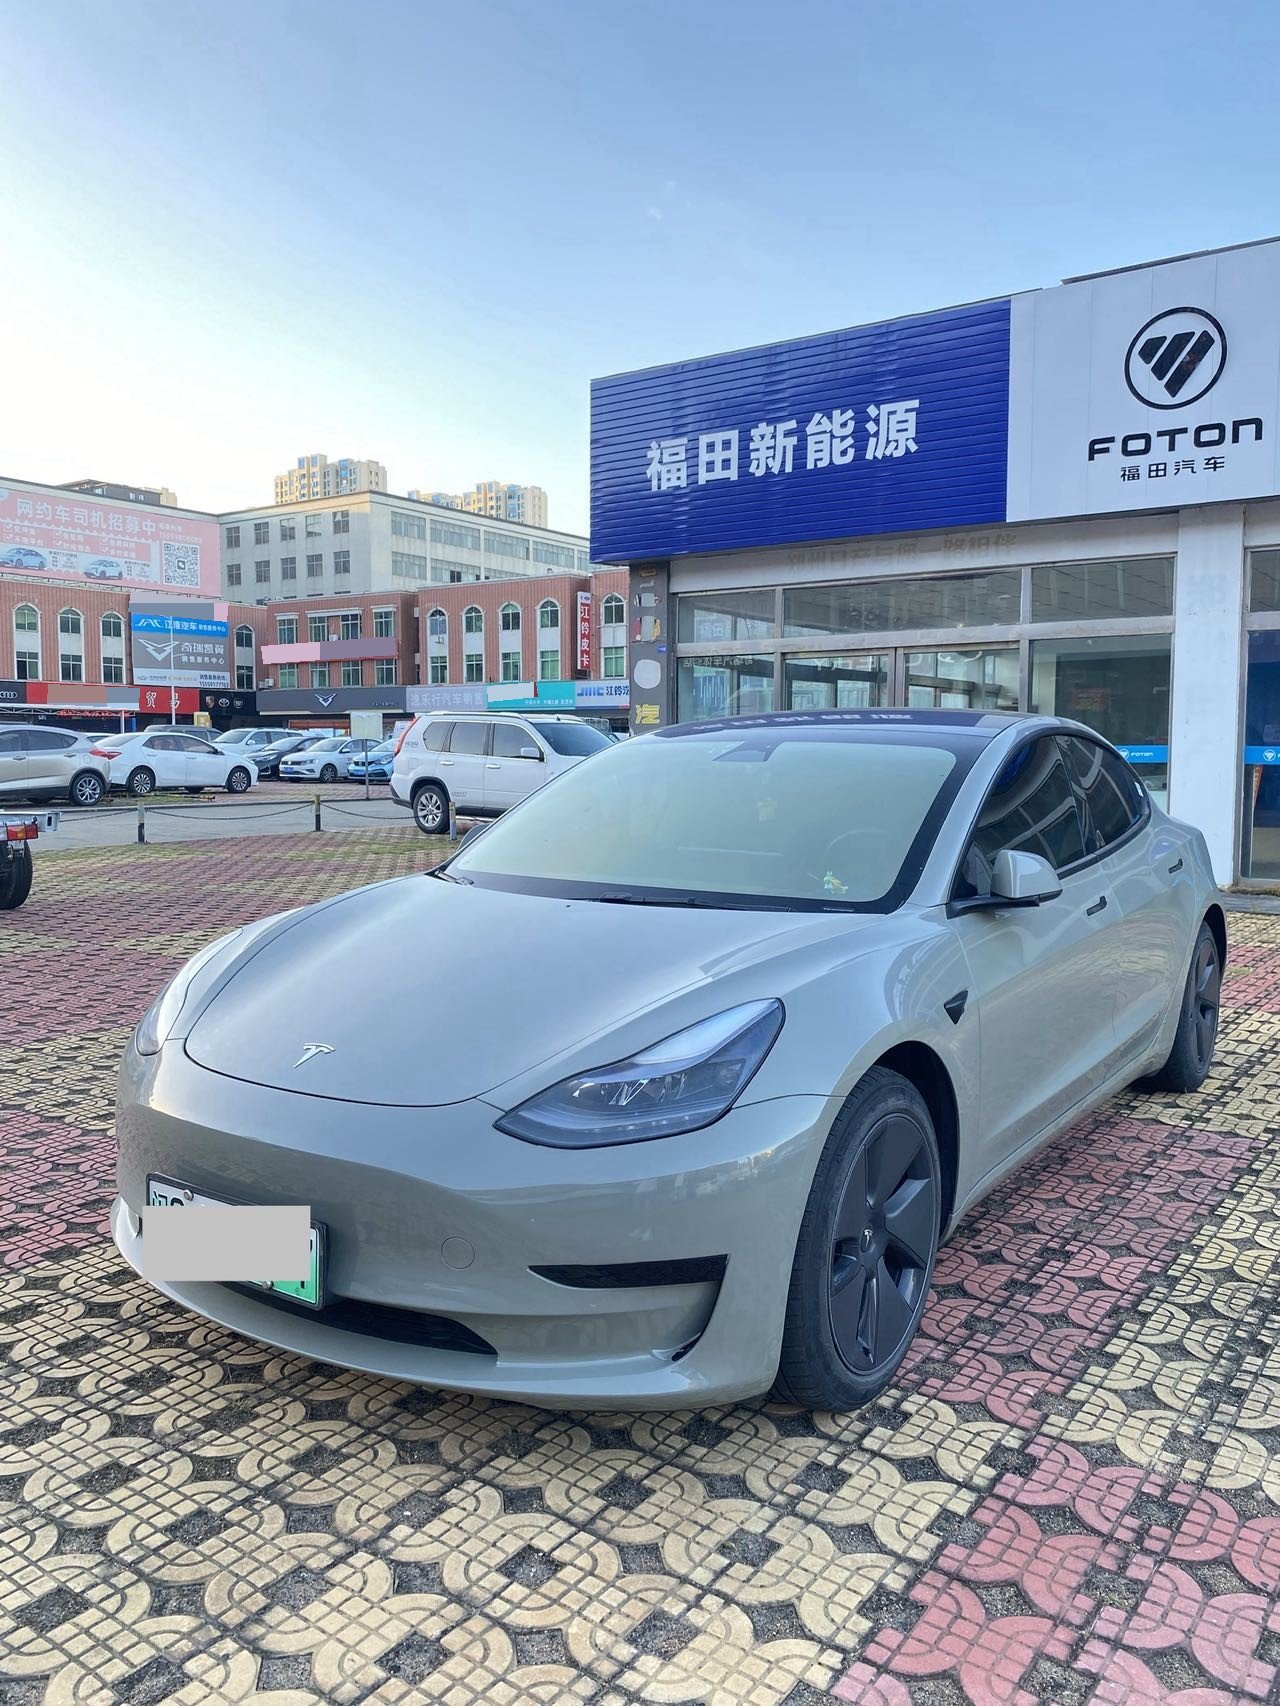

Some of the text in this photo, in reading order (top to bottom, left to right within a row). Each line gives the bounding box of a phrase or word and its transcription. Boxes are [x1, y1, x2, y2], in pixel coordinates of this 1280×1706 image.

[646, 399, 919, 491] 福田新能源
[1088, 417, 1263, 461] FOTON
[1120, 456, 1225, 482] 福田汽车
[17, 499, 155, 536] 网约车司机招募中
[165, 620, 197, 631] 江淮汽车
[580, 606, 590, 667] 江铃皮卡
[181, 642, 224, 655] 奇瑞凯翼
[181, 655, 225, 665] 销售服务中心
